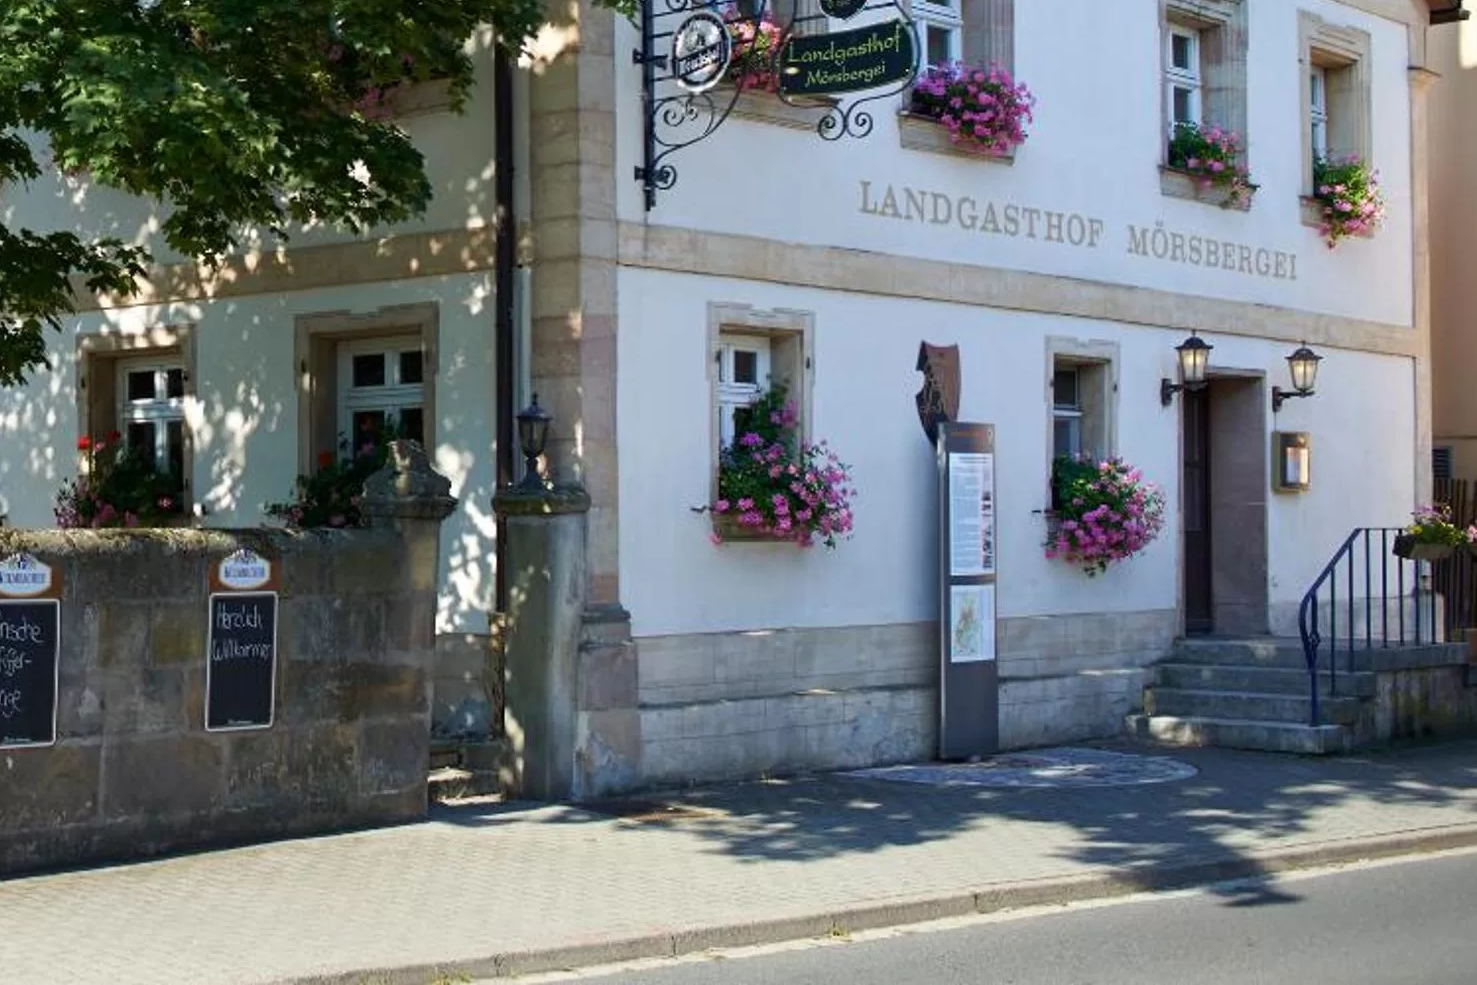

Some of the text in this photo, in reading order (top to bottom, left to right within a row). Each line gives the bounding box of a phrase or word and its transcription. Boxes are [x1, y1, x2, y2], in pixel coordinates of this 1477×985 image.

[788, 23, 901, 65] Landgasthof
[805, 62, 886, 88] Mörsbergei
[859, 181, 1298, 280] LANDGASTHOF MÖRSBERGEI
